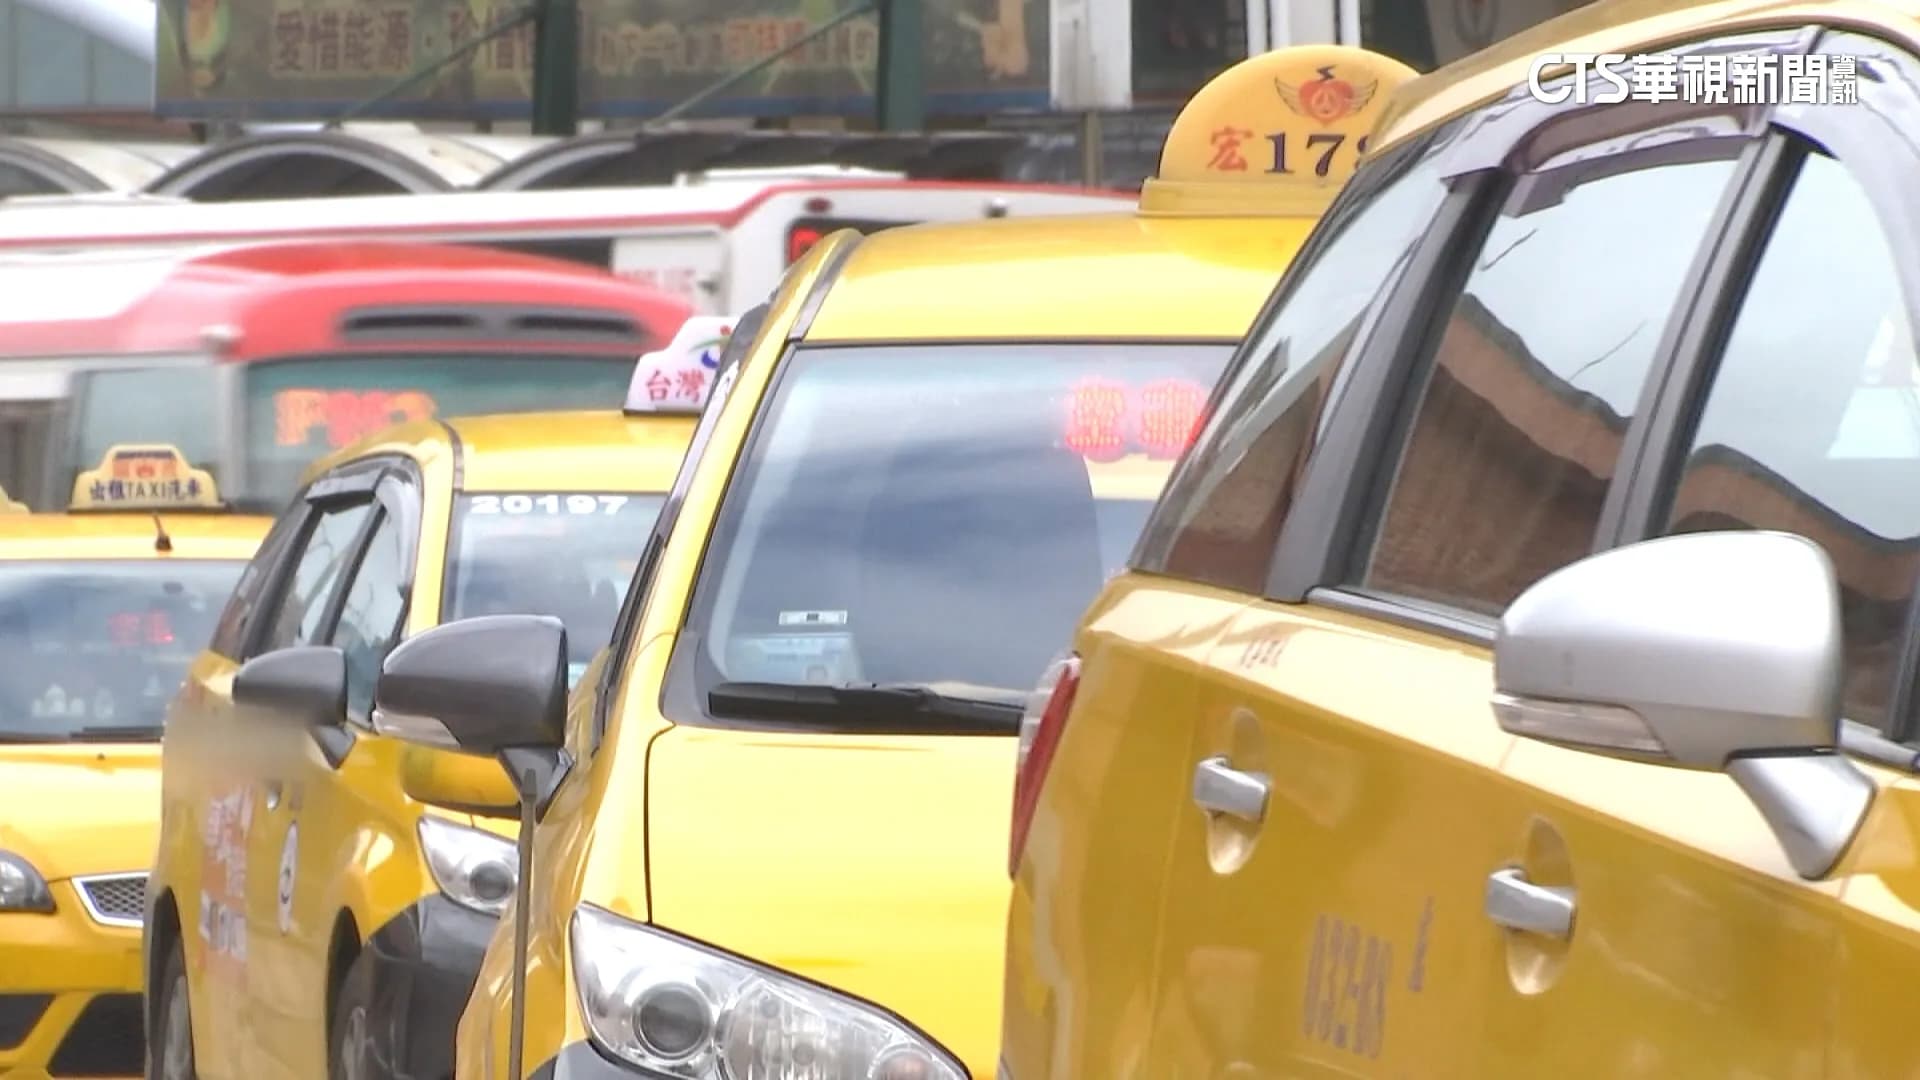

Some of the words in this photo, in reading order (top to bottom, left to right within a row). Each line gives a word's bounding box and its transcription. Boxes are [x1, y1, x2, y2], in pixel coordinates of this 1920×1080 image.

[1207, 127, 1254, 172] 宏
[645, 369, 704, 403] 台灣
[470, 495, 629, 515] 20197
